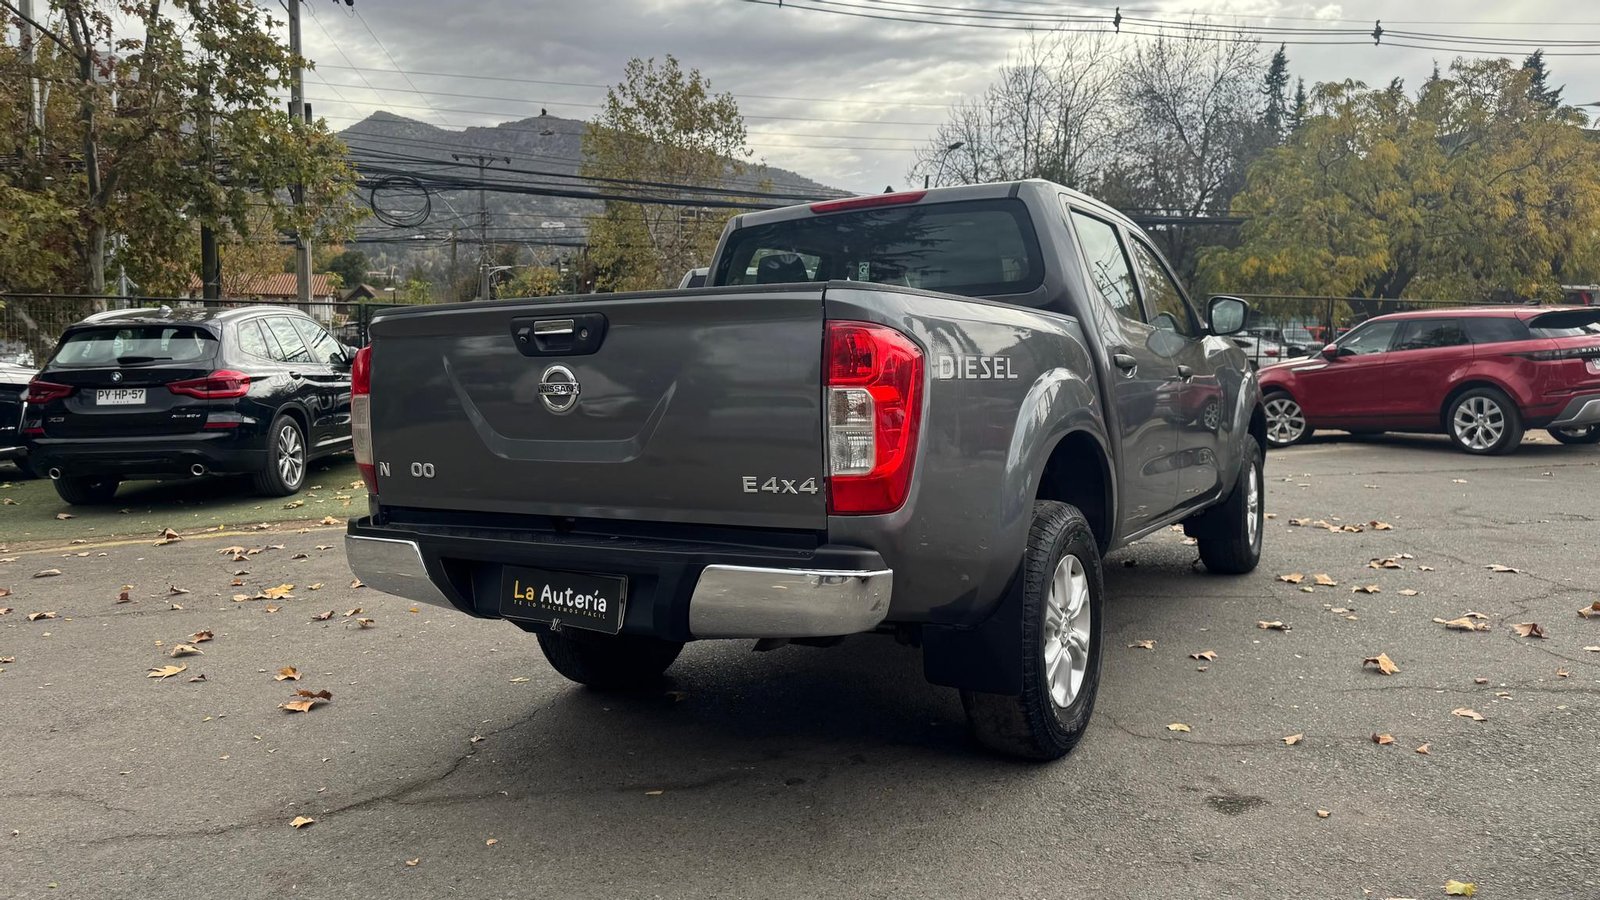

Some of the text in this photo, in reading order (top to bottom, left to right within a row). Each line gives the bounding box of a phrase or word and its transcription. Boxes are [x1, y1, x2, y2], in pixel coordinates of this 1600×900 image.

[939, 355, 1018, 379] DIESEL
[540, 384, 574, 394] NISSAN
[514, 580, 607, 613] La Autería
